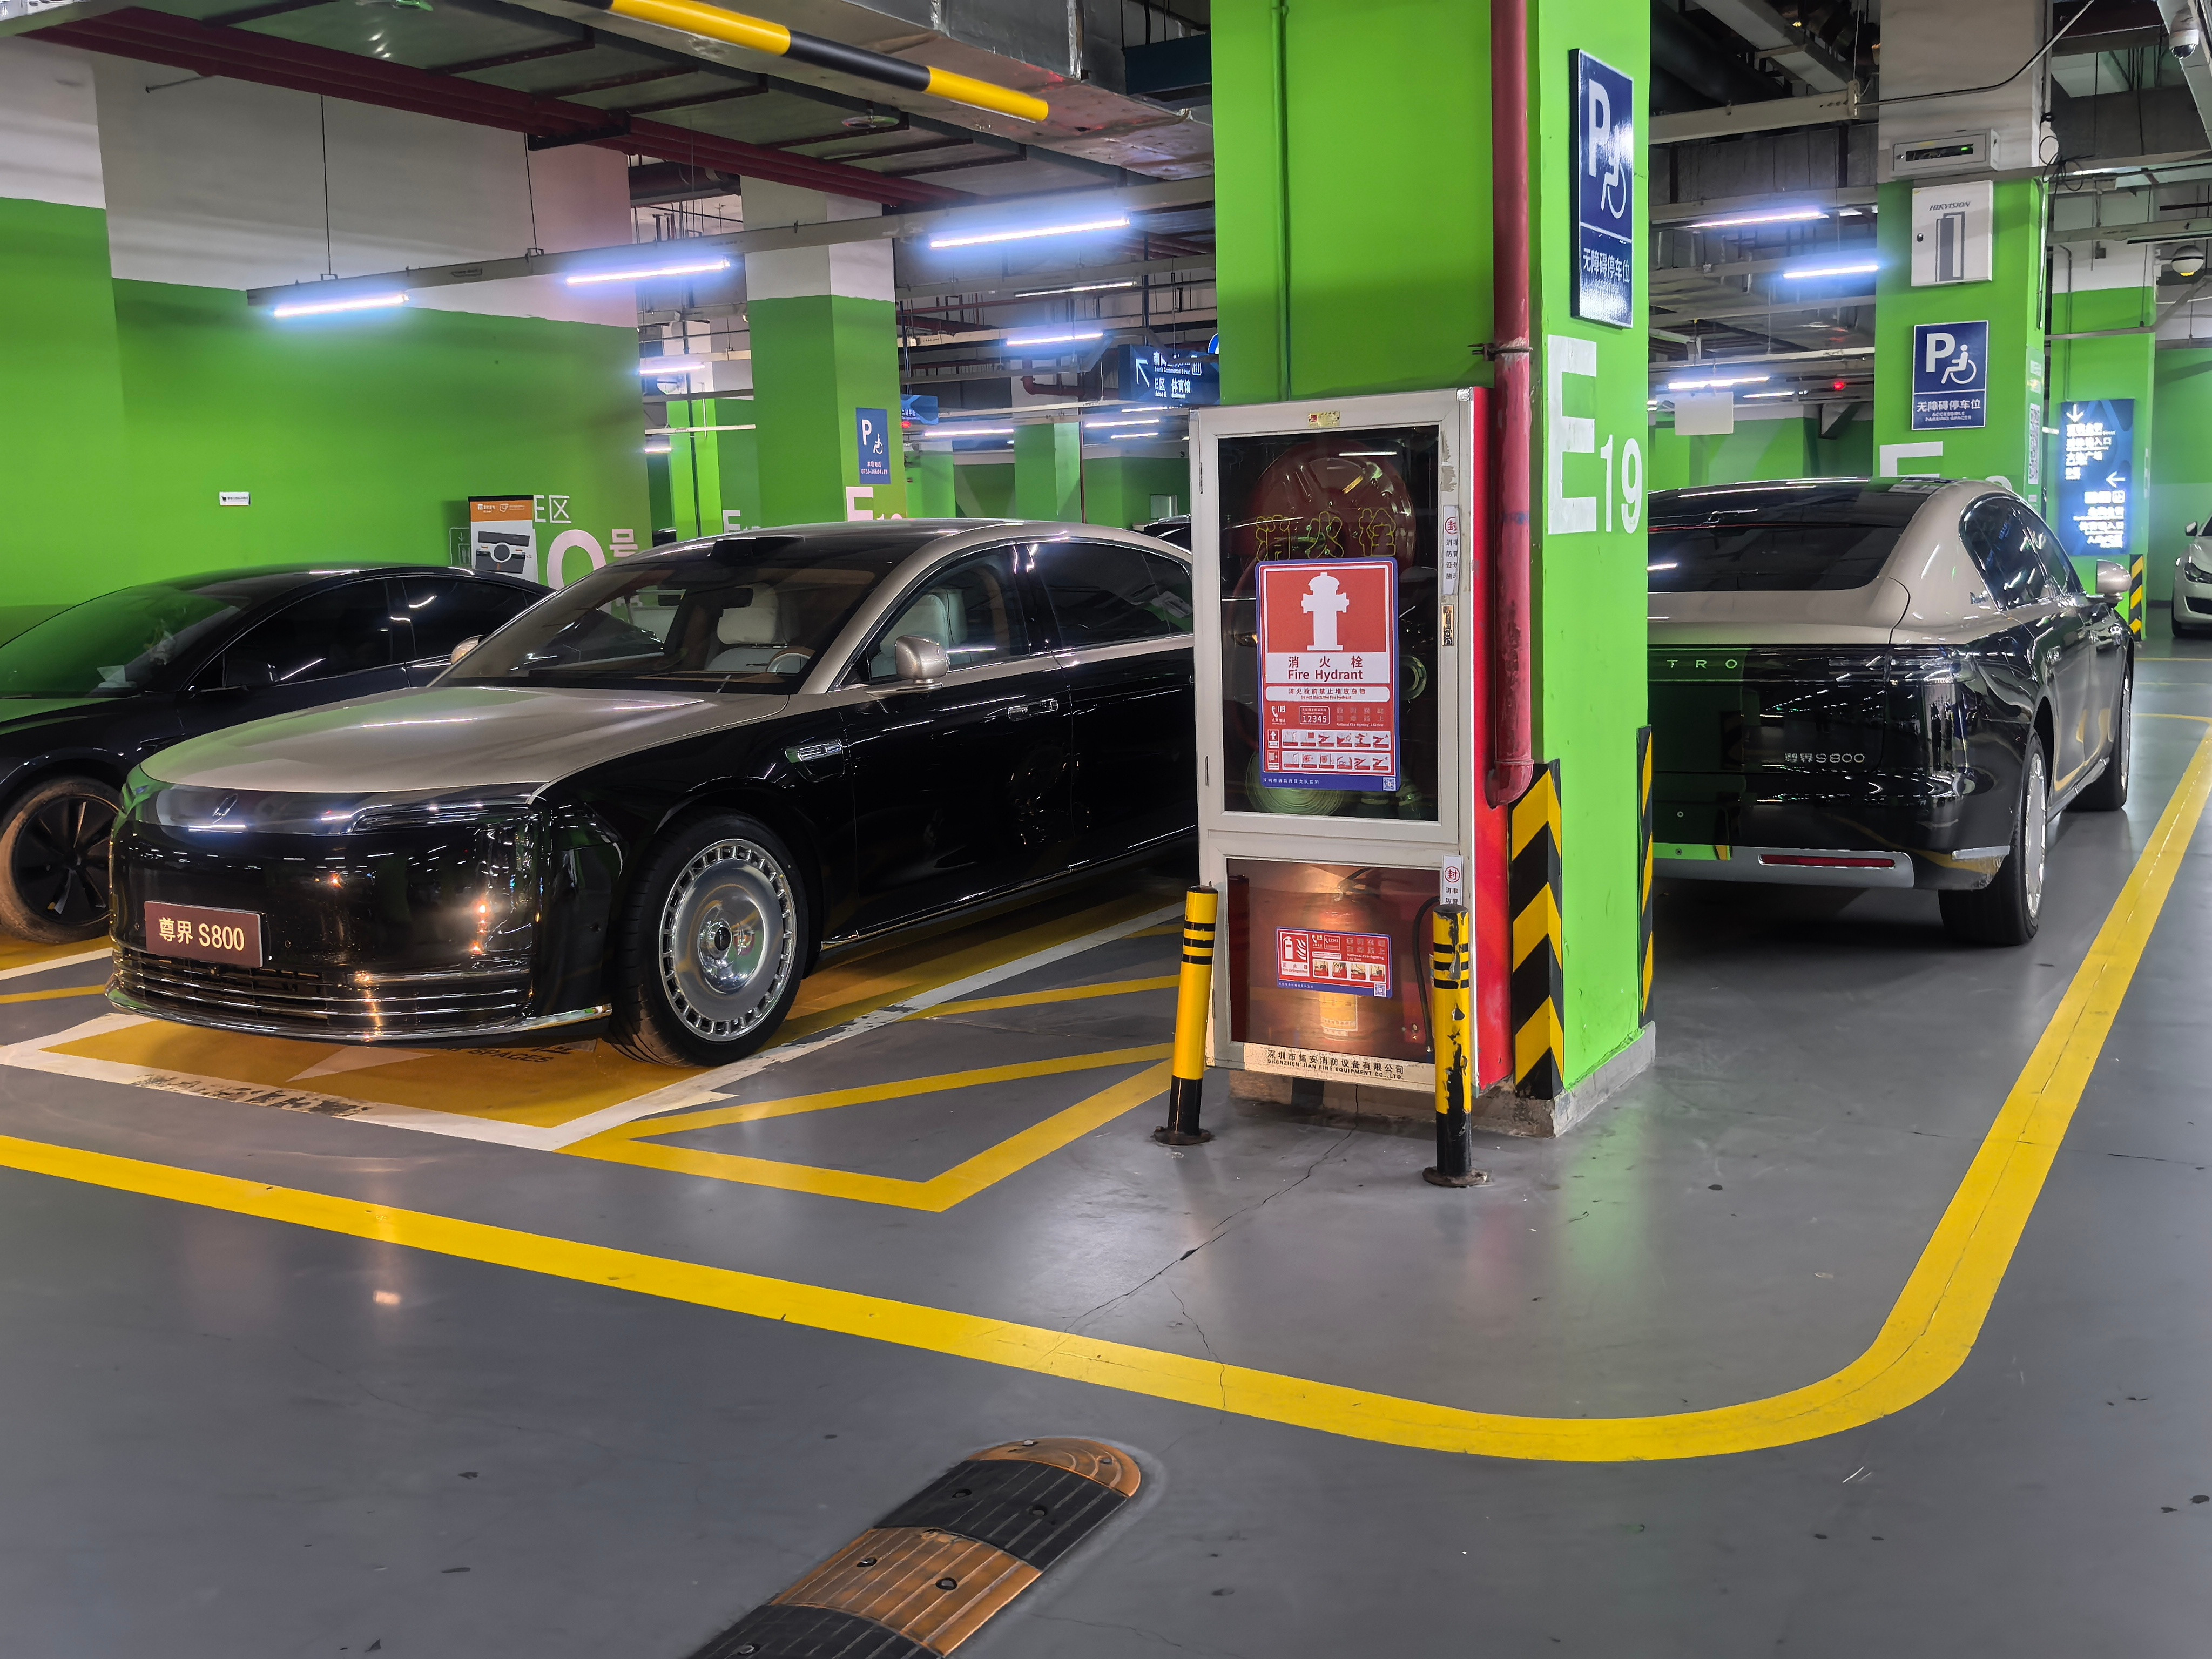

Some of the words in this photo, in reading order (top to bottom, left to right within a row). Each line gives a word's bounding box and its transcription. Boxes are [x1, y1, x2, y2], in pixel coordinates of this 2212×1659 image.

[1929, 201, 1971, 211] HIKVISION
[1583, 248, 1630, 283] 无障碍停车位
[1926, 333, 1955, 373] P
[1917, 399, 1981, 412] 无障碍停车位
[1547, 334, 1642, 535] E19
[1288, 655, 1363, 669] 消火栓
[1288, 669, 1310, 680] Fire
[1315, 670, 1363, 682] Hydrant
[1303, 715, 1327, 723] 12345
[159, 916, 193, 945] 尊界
[198, 923, 245, 951] S800
[1267, 1049, 1404, 1075] 深圳市集安消防设备有限公司
[1336, 1067, 1372, 1076] EQUIPMENT
